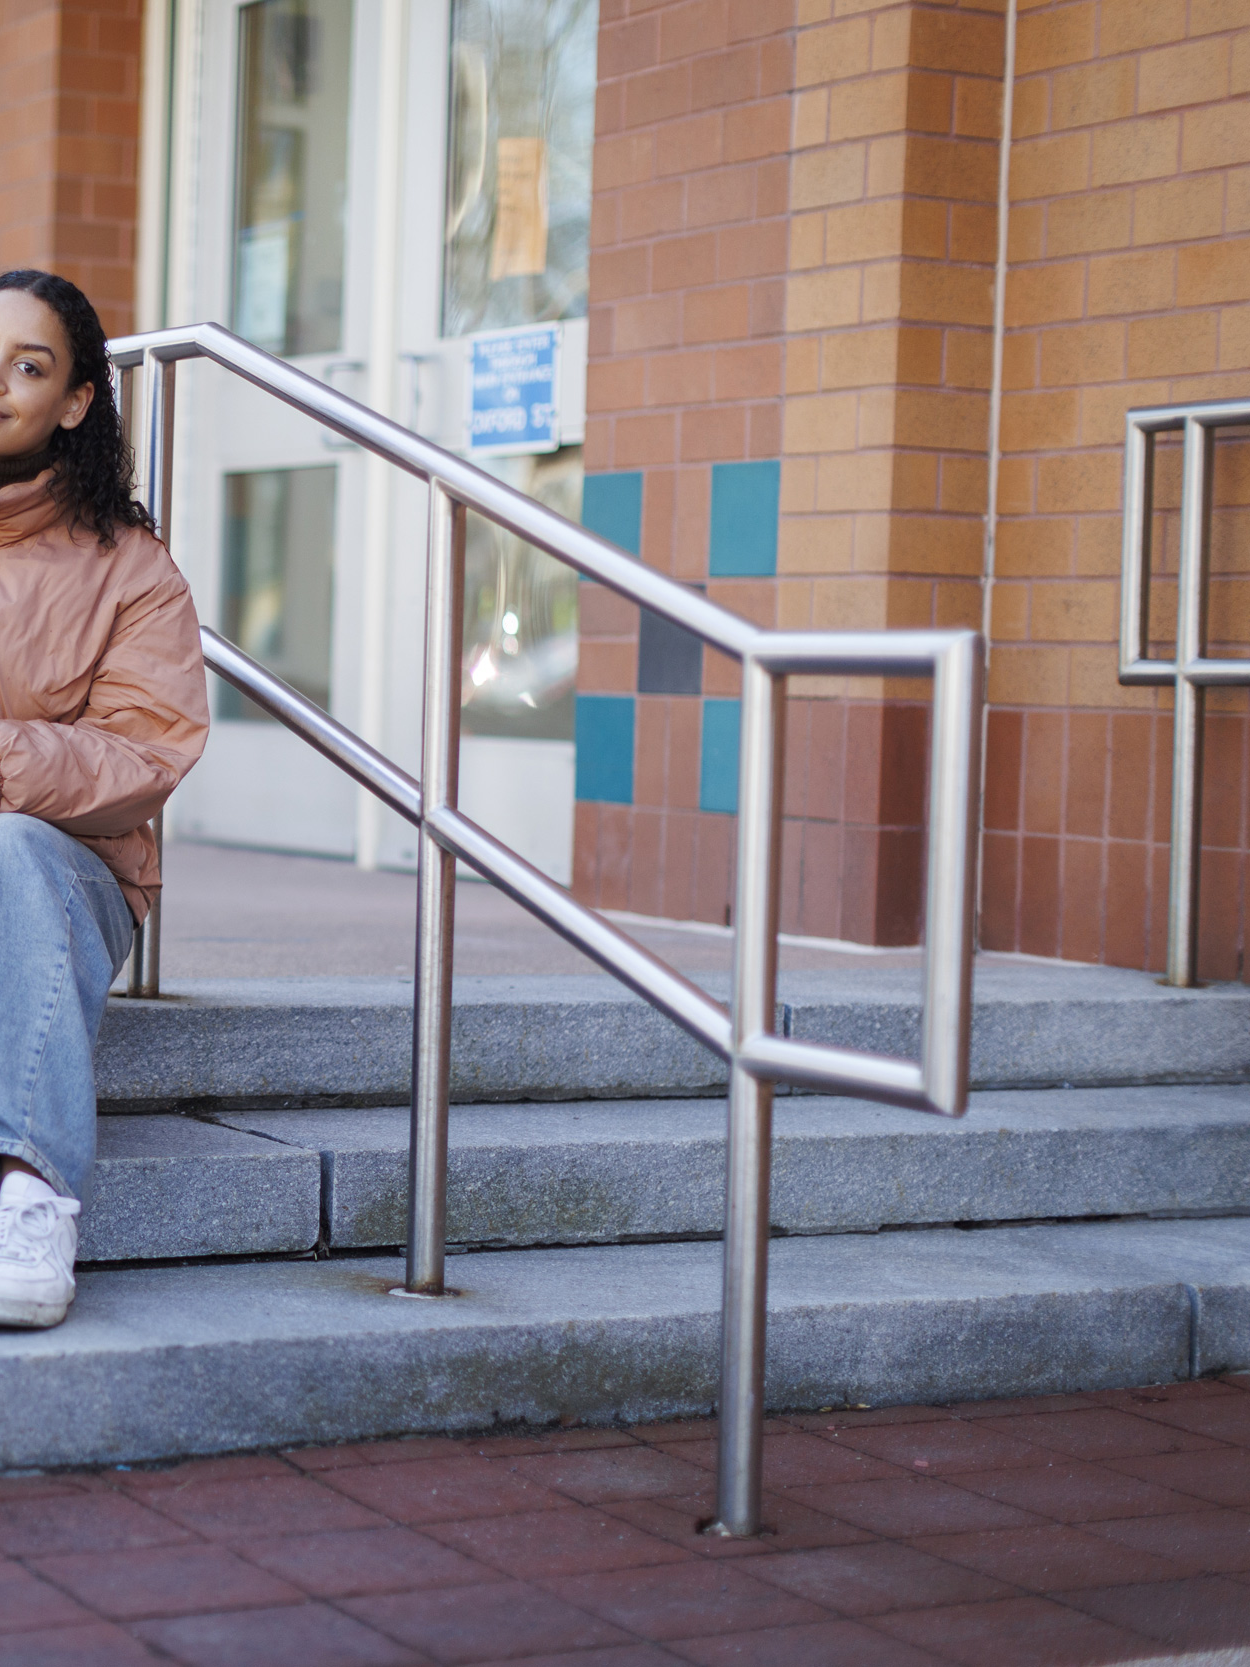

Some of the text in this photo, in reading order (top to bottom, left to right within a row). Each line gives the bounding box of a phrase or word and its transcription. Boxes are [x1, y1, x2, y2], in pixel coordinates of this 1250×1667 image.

[515, 335, 549, 351] ENTER
[501, 364, 553, 384] ENTRANCE
[471, 406, 528, 434] OXFORD
